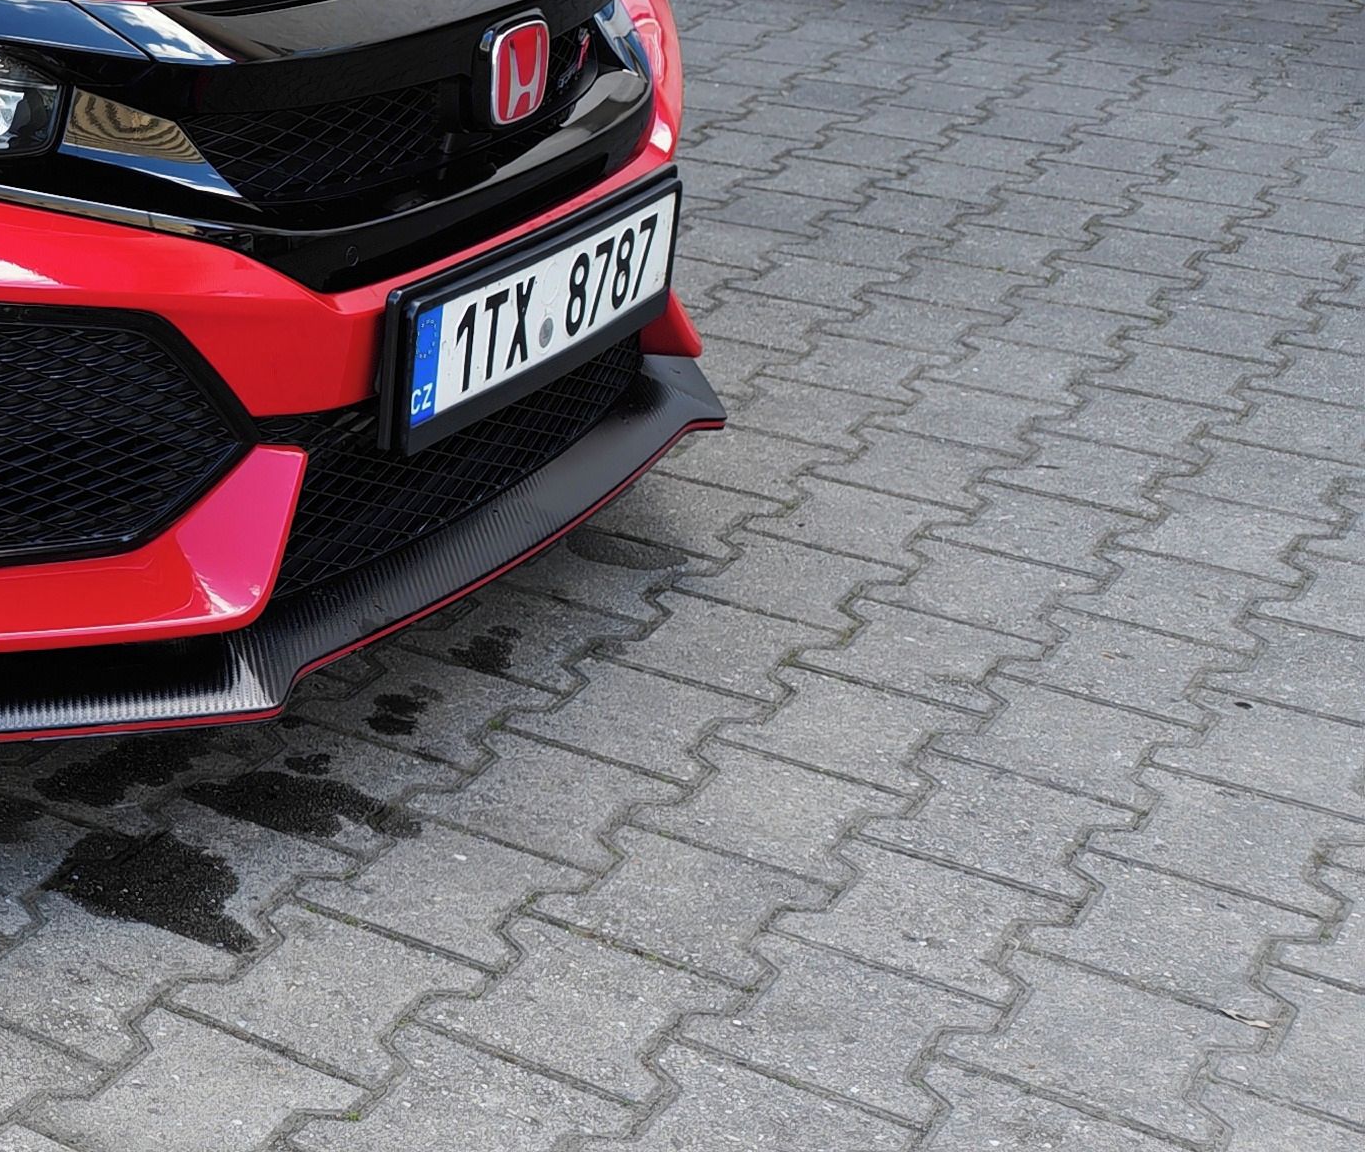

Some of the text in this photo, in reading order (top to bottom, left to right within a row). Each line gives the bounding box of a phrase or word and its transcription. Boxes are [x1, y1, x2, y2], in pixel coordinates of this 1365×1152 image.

[455, 212, 659, 394] 1TX 8787
[410, 382, 434, 415] CZ
